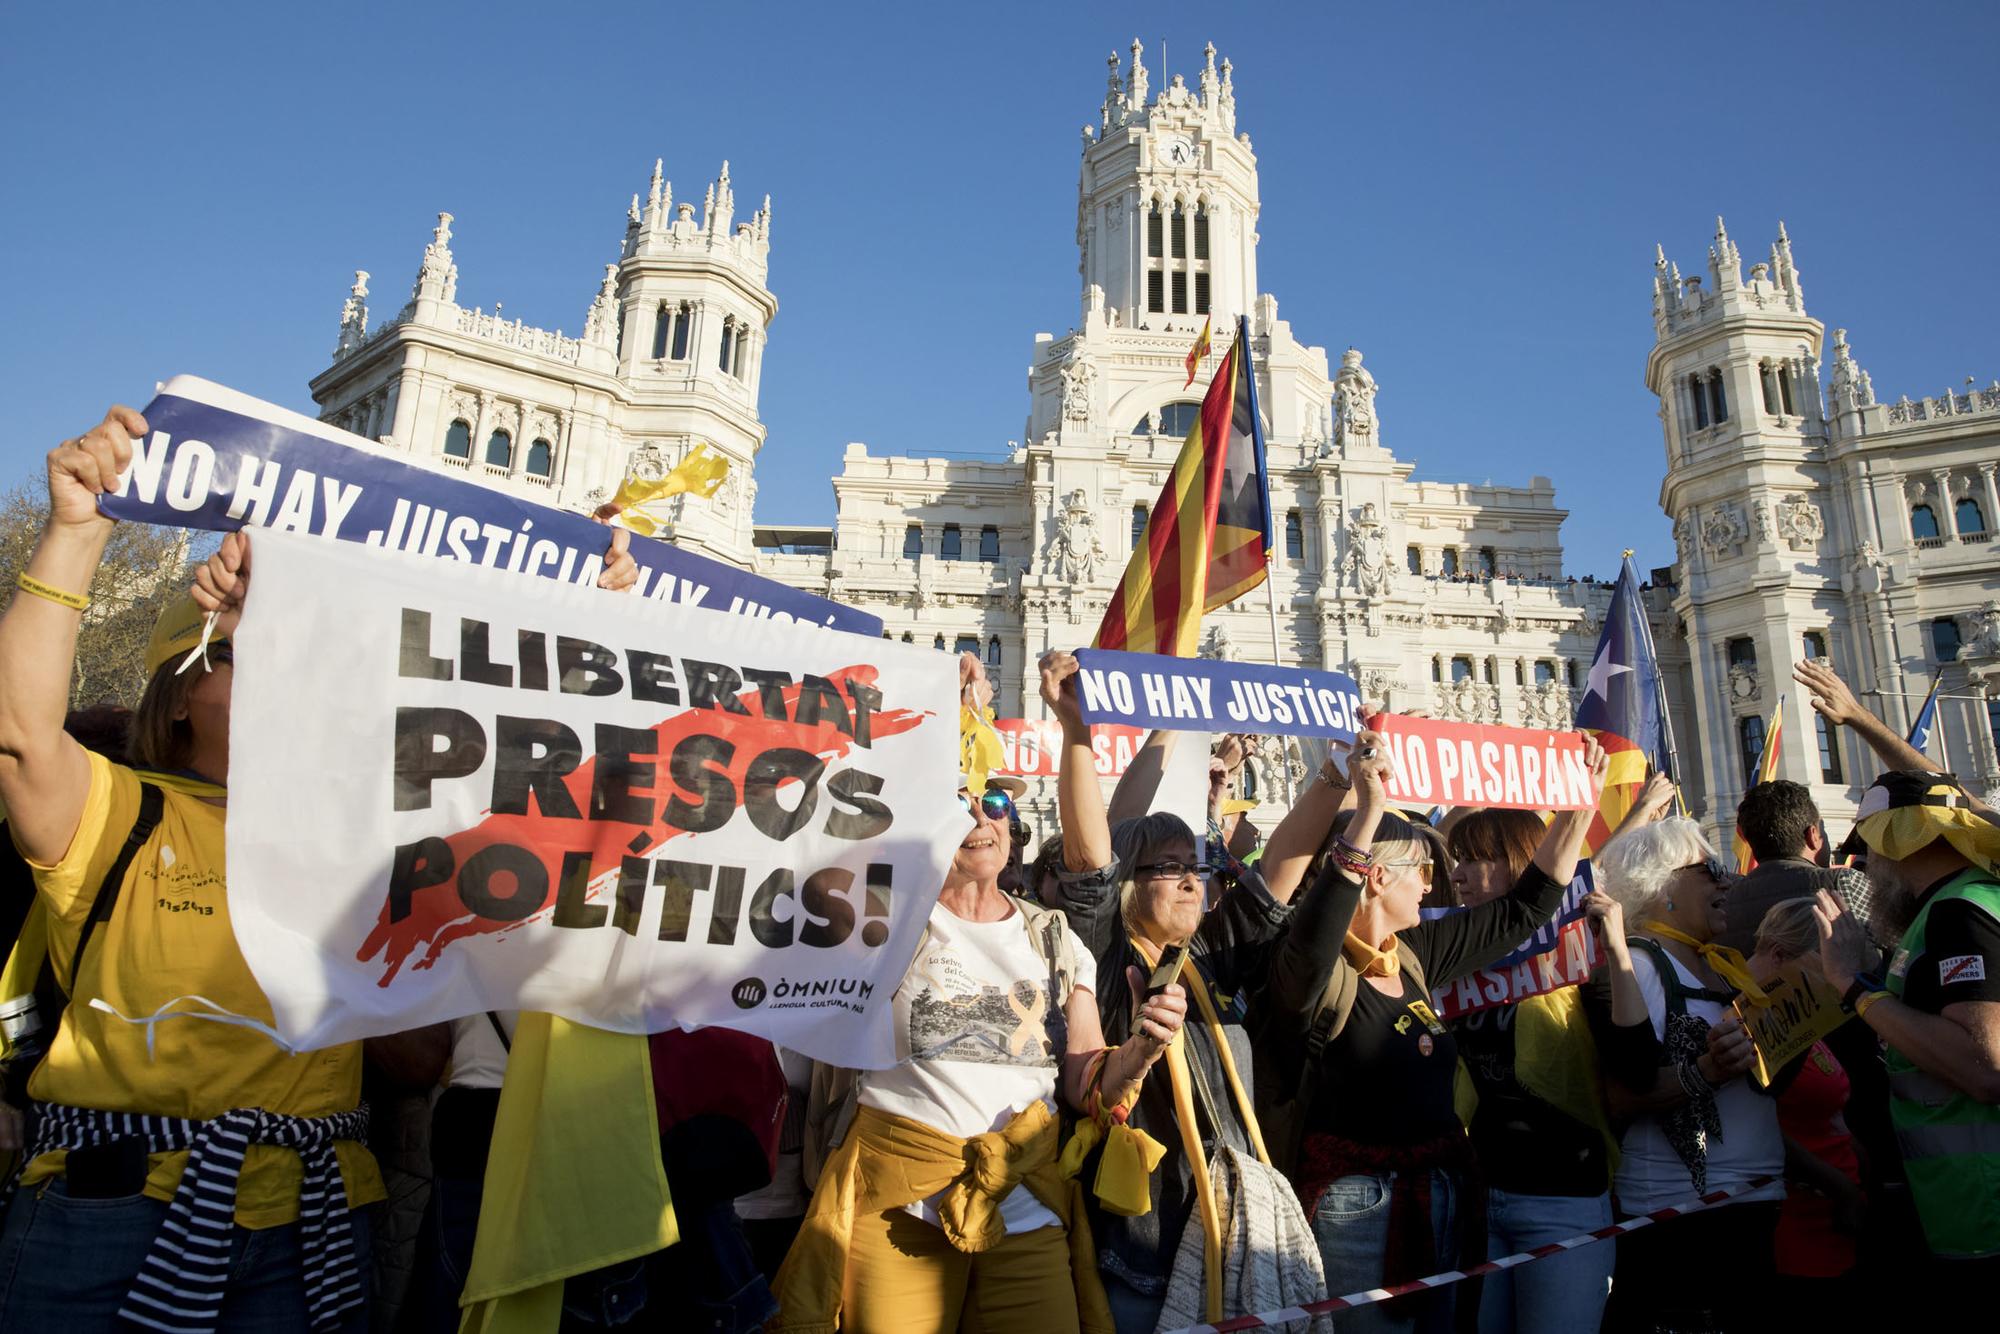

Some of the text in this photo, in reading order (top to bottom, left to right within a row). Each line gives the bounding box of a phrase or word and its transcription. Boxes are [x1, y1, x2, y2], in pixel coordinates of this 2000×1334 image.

[116, 430, 216, 512] NO
[226, 454, 364, 542] HAY
[1079, 668, 1366, 734] NO HAY JUSTÍCIA
[393, 706, 895, 841] PRESOS
[1379, 731, 1594, 806] NO PASARÁN
[389, 831, 894, 949] POLÍTICS!
[773, 977, 875, 1000] ÒMNIUM
[809, 1000, 849, 1009] CULTURA
